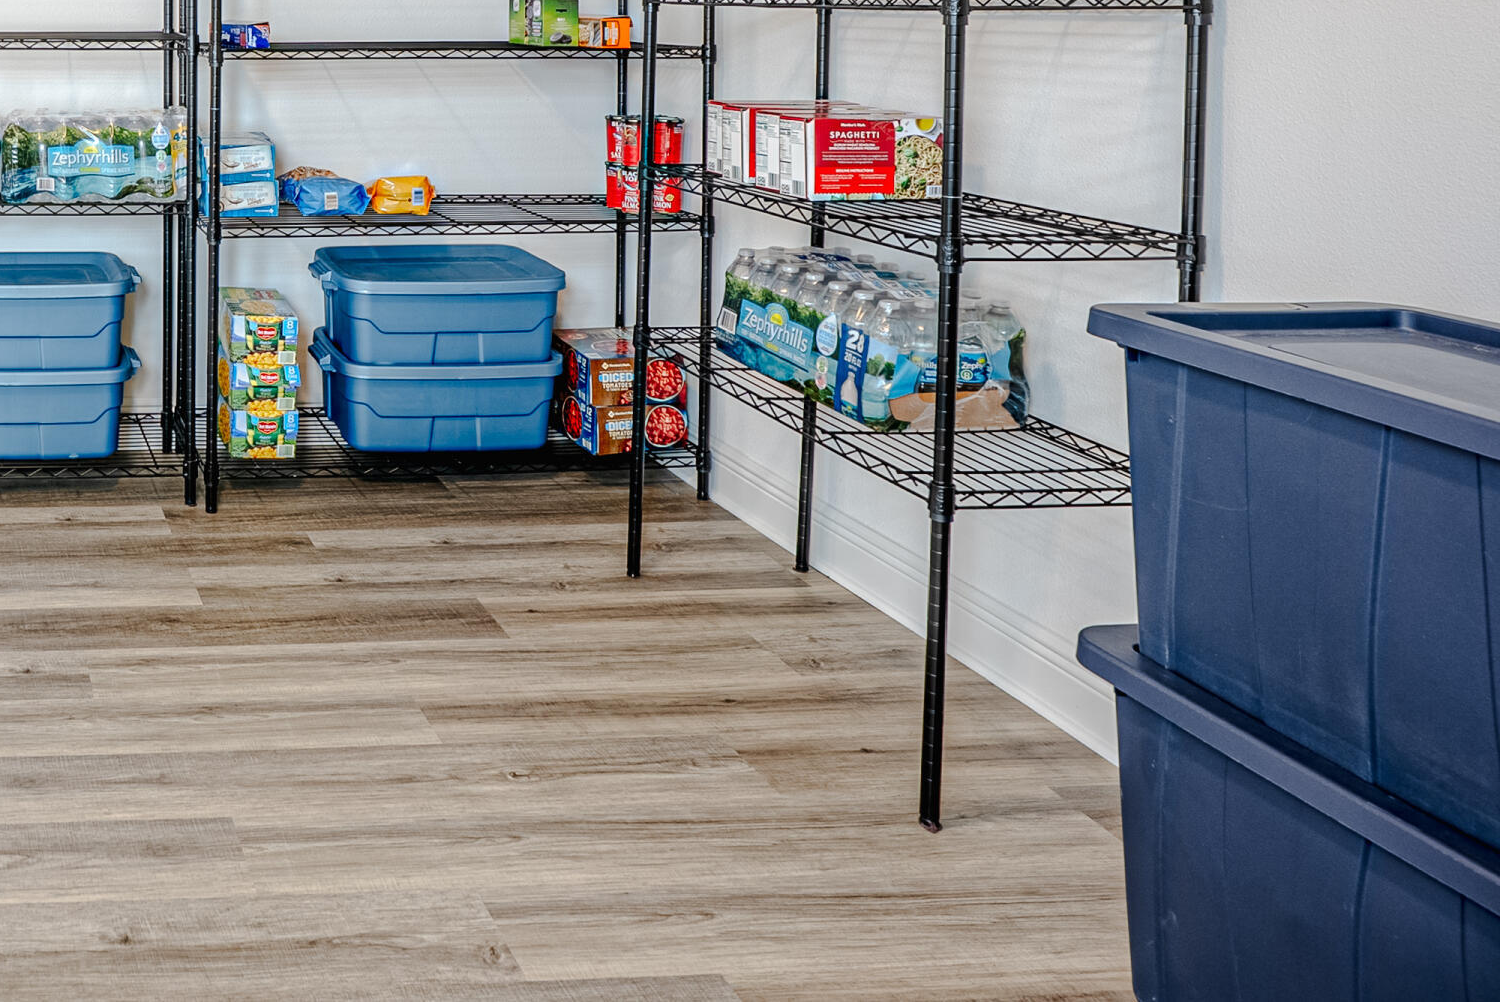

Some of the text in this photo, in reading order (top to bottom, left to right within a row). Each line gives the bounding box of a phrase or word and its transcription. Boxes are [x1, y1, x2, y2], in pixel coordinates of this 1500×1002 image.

[829, 131, 880, 139] SPAGHETTI
[52, 149, 129, 167] Zephyrhills
[286, 320, 294, 329] 8
[742, 307, 808, 353] Zephyrhills
[602, 373, 634, 383] DICED
[287, 414, 295, 423] 8
[608, 421, 633, 432] DICE
